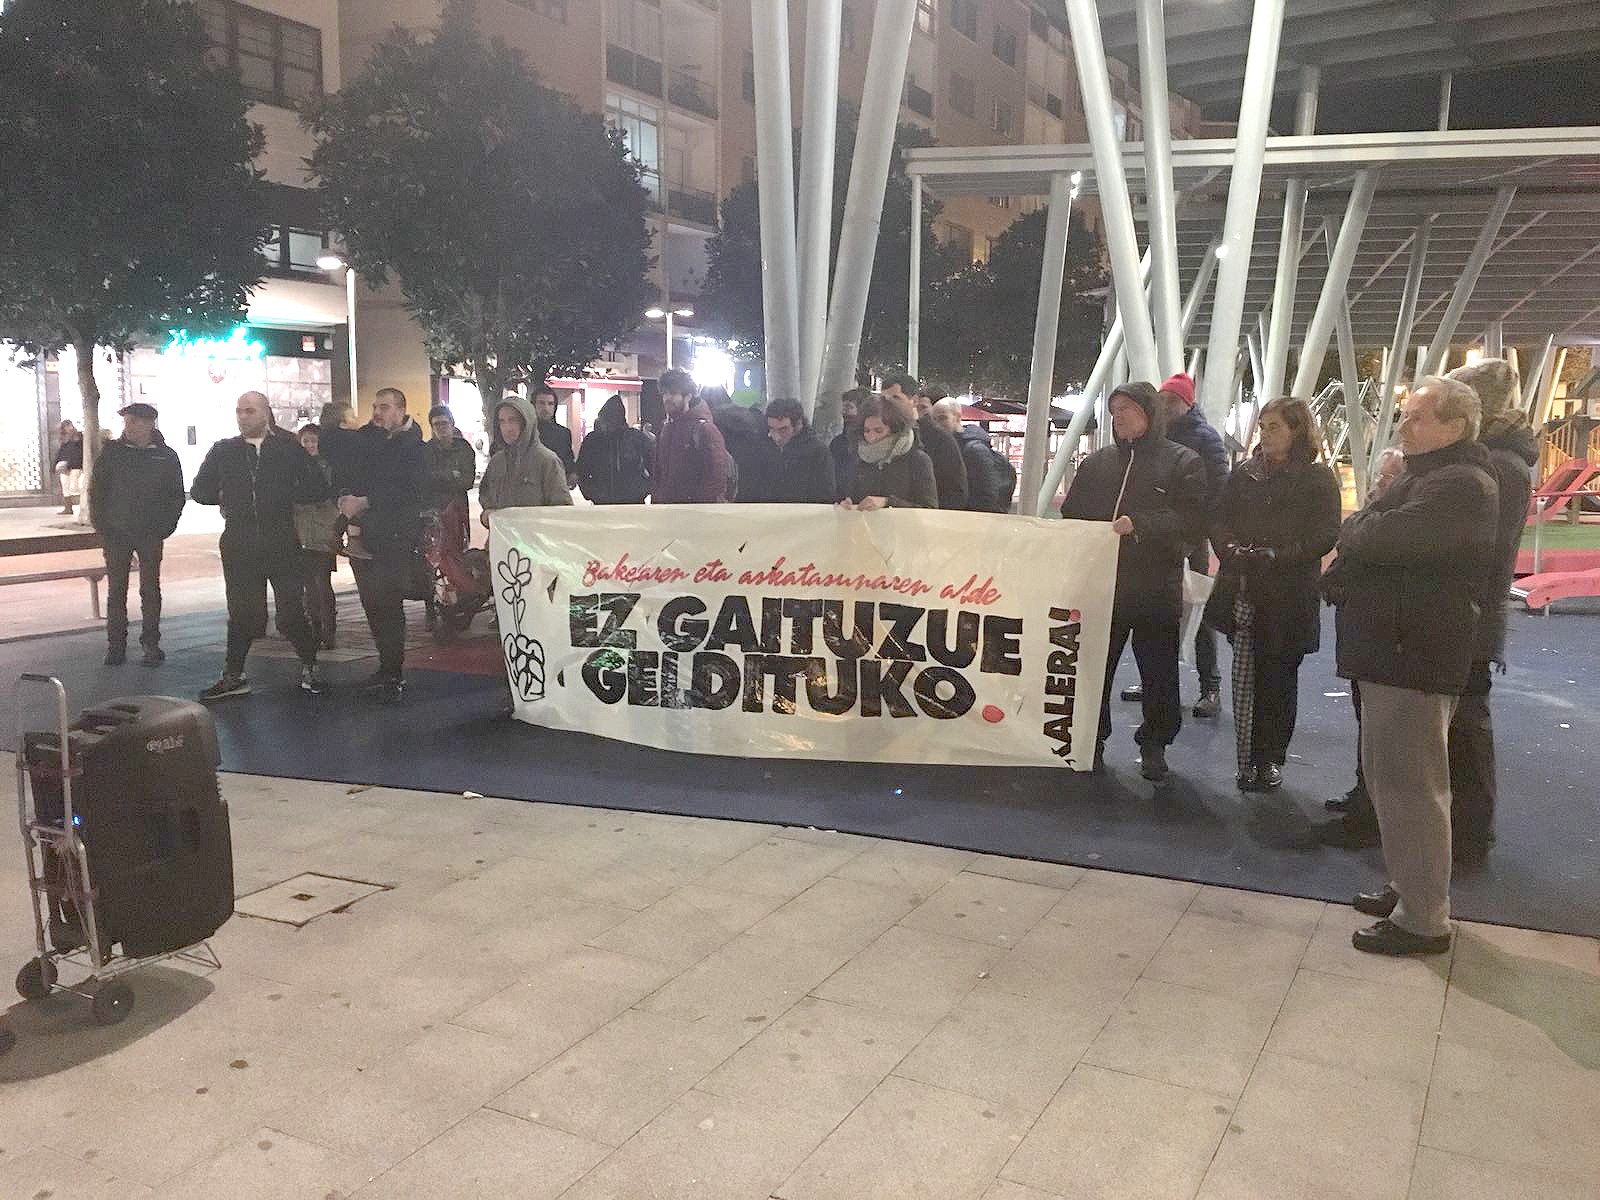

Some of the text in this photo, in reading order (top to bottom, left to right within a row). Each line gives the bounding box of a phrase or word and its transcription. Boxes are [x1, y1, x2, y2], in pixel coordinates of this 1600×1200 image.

[582, 552, 1002, 606] Bakearen eta askatasunaren alde
[569, 593, 1024, 676] EZ GAITUZUE
